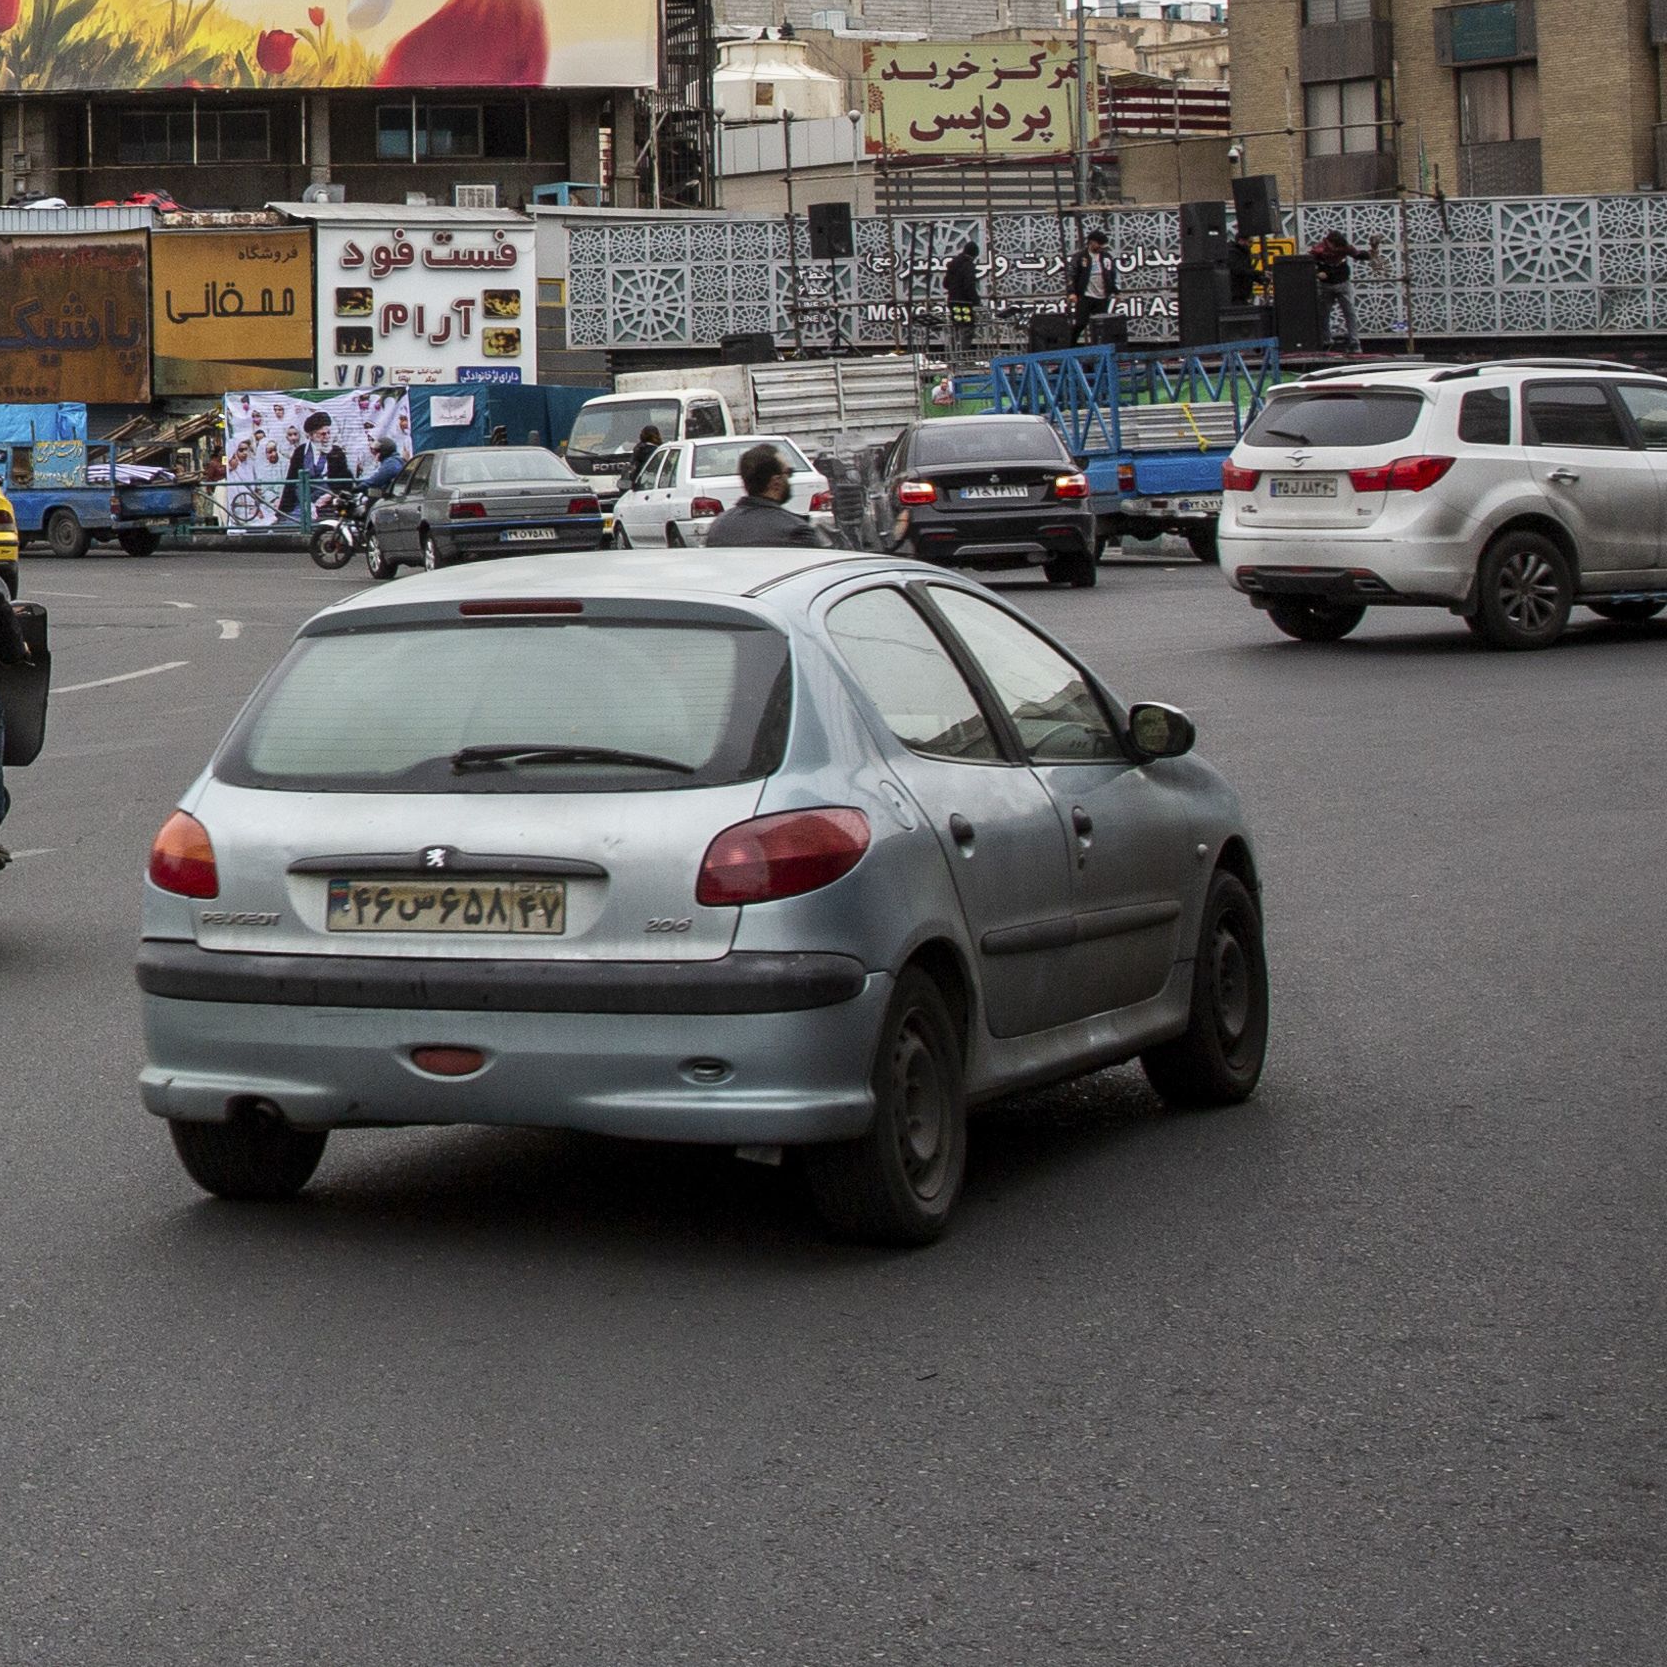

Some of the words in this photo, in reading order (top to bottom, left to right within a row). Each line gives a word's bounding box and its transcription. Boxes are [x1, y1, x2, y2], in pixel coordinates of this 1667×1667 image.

[881, 52, 980, 90] خرید
[986, 52, 1079, 90] مرکز
[909, 102, 1052, 143] پردیس
[237, 243, 298, 263] فروشگاه
[341, 227, 416, 279] فود
[423, 228, 518, 270] فست
[381, 297, 476, 346] آرام
[798, 315, 818, 323] LINE
[334, 364, 385, 387] VIP
[201, 911, 281, 927] PEUGEOT
[644, 916, 693, 933] 206
